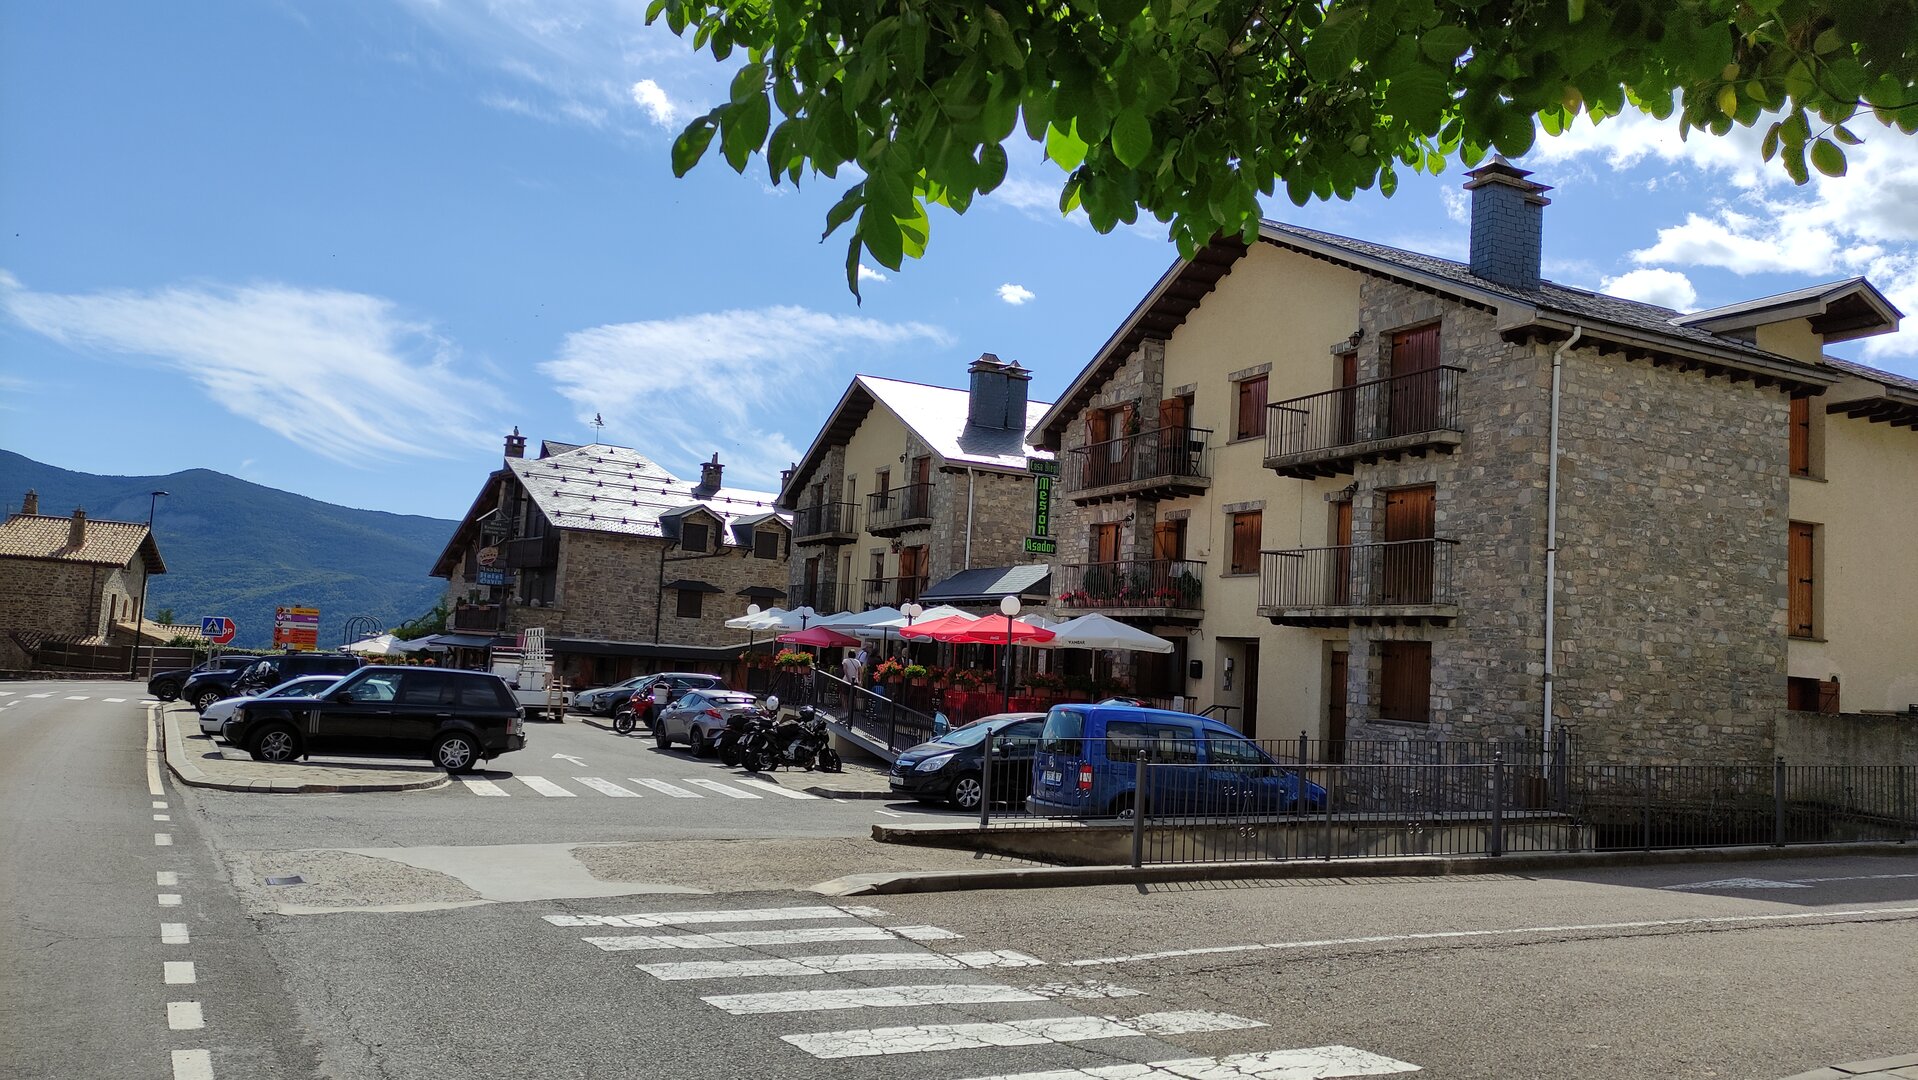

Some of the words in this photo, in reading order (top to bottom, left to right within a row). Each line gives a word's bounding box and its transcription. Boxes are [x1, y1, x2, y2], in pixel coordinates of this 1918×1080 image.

[1038, 477, 1049, 535] Mesón
[1026, 539, 1056, 553] Asador
[480, 572, 503, 580] Hotel
